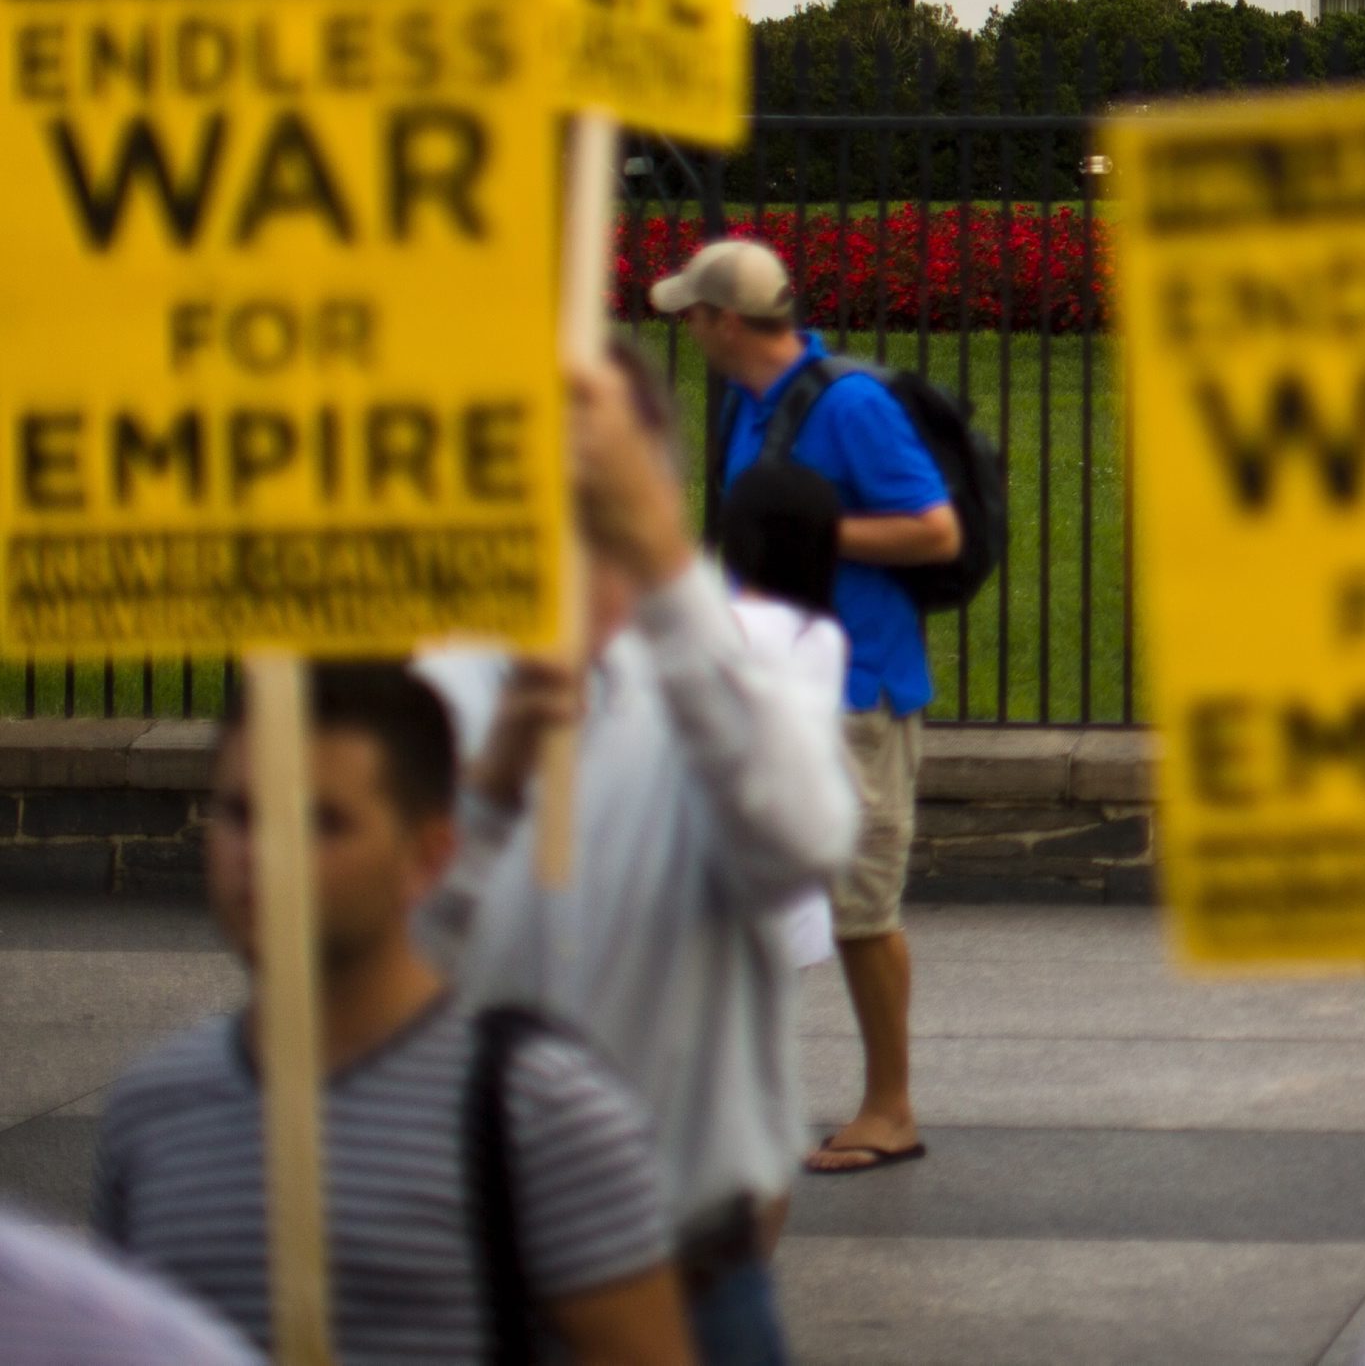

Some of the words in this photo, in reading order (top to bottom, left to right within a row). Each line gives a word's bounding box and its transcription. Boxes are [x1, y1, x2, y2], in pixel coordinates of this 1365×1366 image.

[18, 10, 516, 104] ENDLESS
[50, 104, 492, 254] WAR
[168, 294, 382, 376] FOR
[20, 400, 536, 512] EMPIRE
